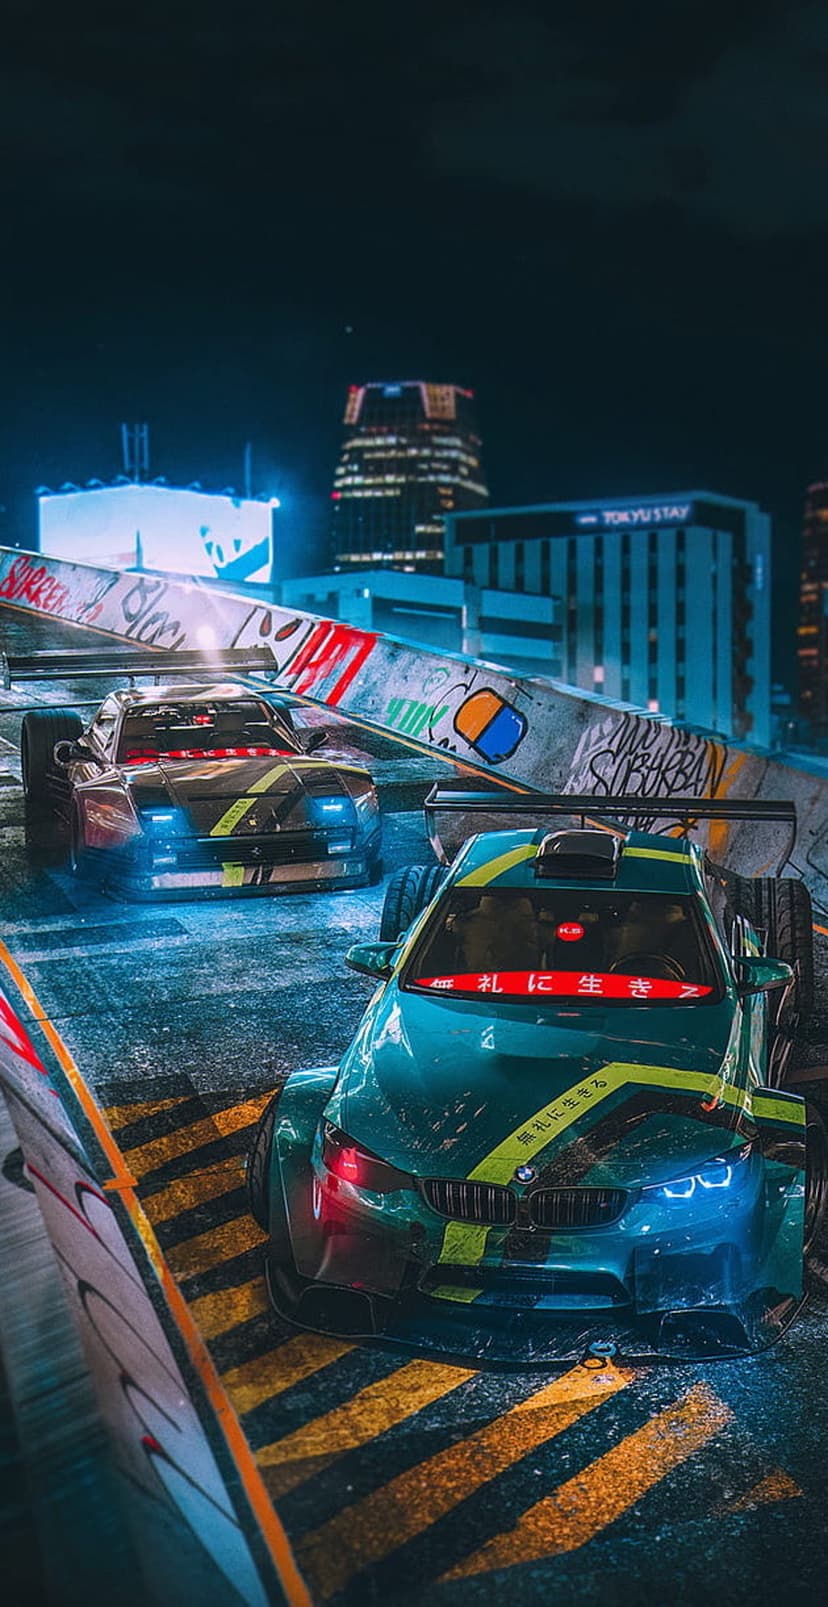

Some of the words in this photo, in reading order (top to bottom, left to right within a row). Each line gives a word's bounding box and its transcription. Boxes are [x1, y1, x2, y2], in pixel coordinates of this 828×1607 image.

[603, 509, 652, 525] TOKYU
[653, 505, 690, 521] STAY
[516, 1078, 608, 1146] 無礼に生きる
